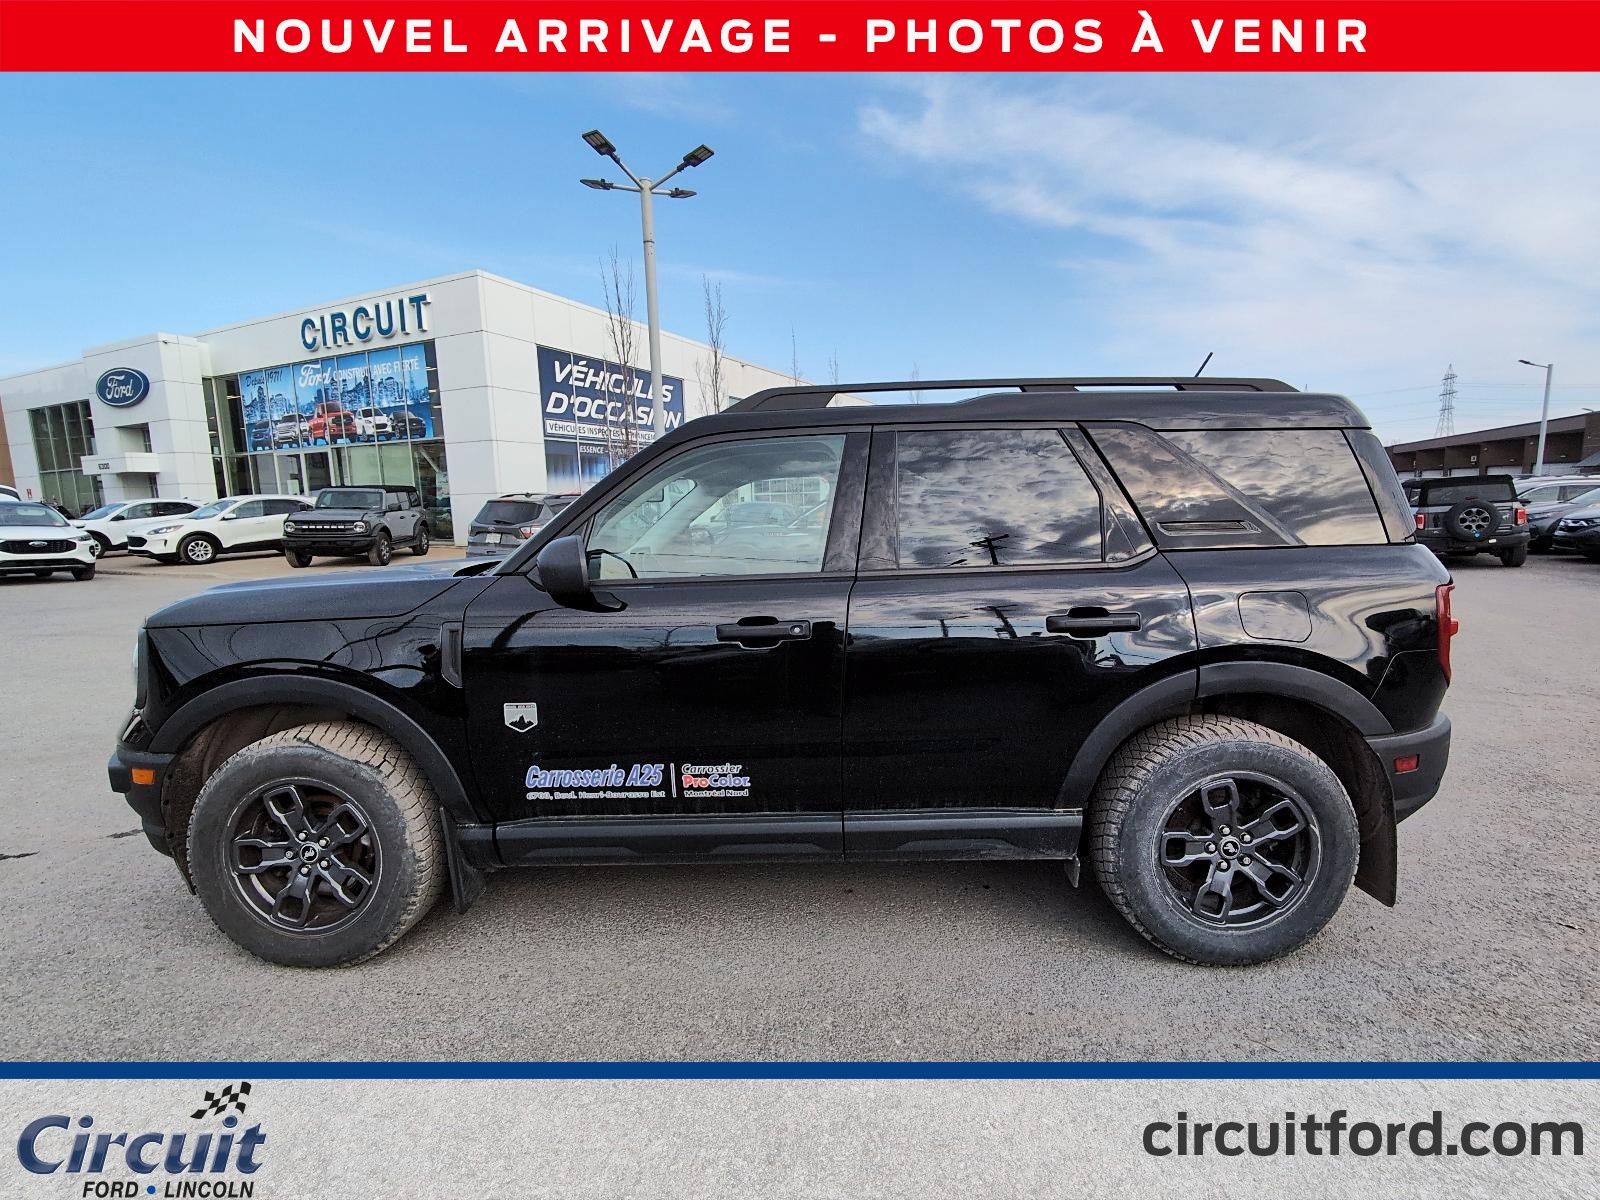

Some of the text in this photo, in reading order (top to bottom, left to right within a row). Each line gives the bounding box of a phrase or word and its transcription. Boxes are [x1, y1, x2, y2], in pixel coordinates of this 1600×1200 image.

[300, 293, 430, 352] CIRCUIT
[299, 363, 332, 387] Ford
[373, 362, 392, 375] AVEC
[105, 375, 134, 400] Ford
[549, 423, 586, 435] VÉHICUES
[580, 446, 604, 454] ESSENCE
[525, 763, 664, 788] Carrosserie A25
[682, 763, 742, 775] Carrossier
[726, 789, 749, 797] Nord
